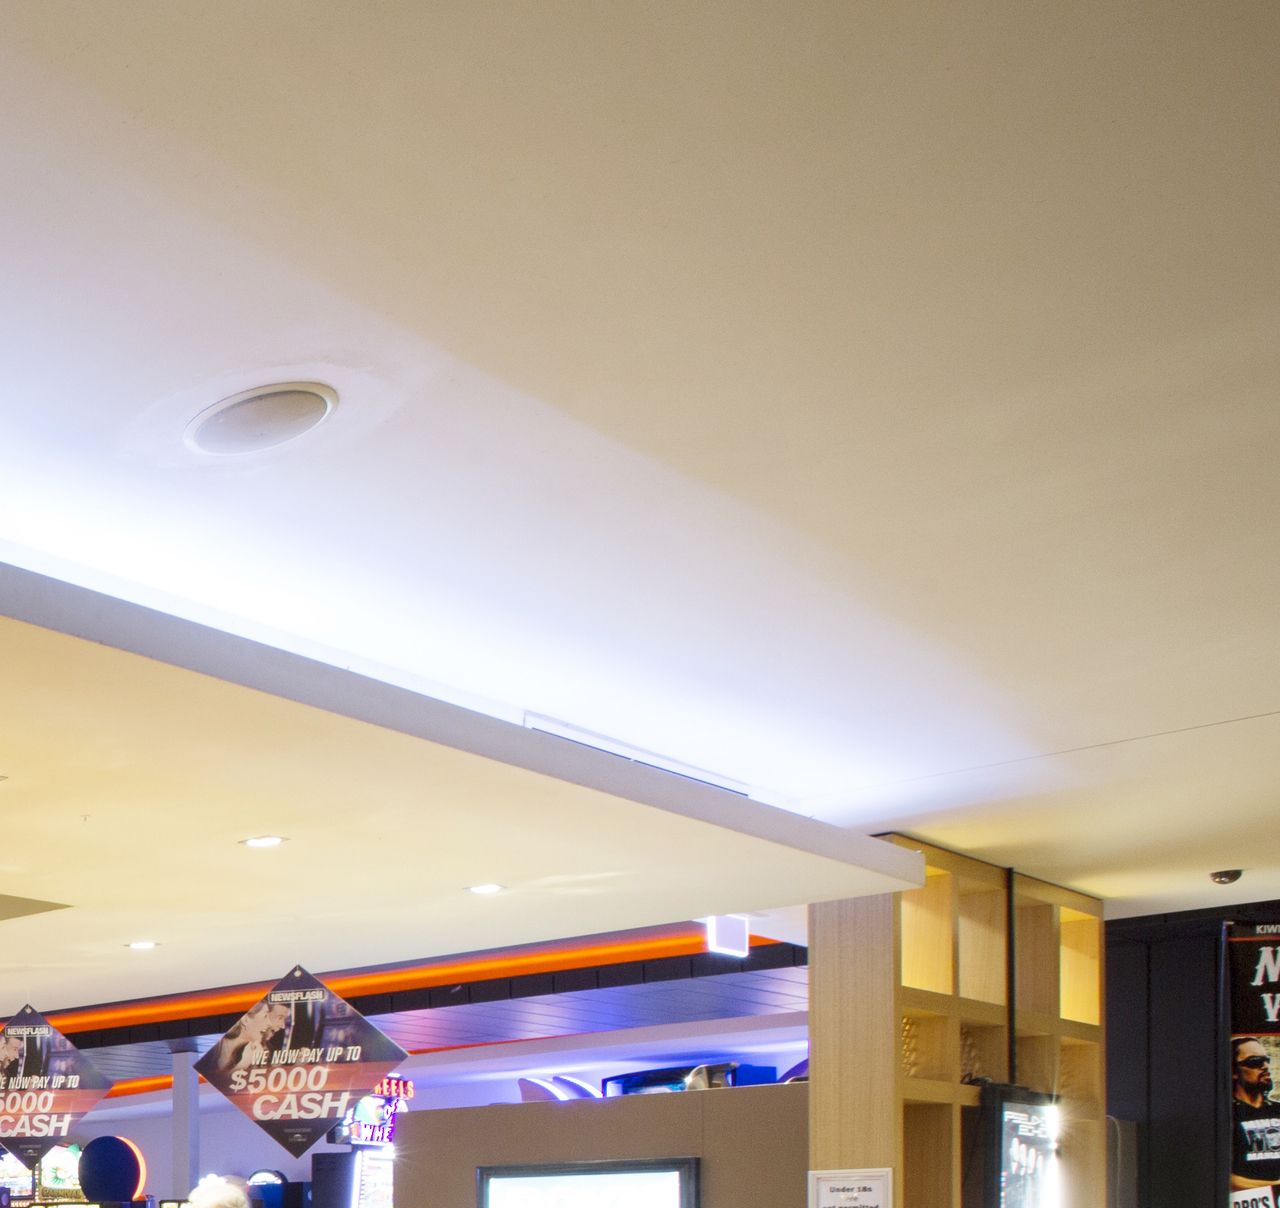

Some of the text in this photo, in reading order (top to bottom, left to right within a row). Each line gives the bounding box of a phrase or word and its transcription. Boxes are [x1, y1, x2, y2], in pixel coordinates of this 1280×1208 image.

[270, 990, 323, 1001] NEWSFLASH
[7, 1027, 49, 1035] NEWSFLASH
[251, 1046, 361, 1066] WE NOW PAY UP TO
[8, 1076, 32, 1089] NOW
[32, 1075, 50, 1089] PAY
[51, 1075, 66, 1088] UP
[67, 1075, 80, 1088] TO
[229, 1066, 329, 1094] $5000
[252, 1091, 351, 1121] CASH
